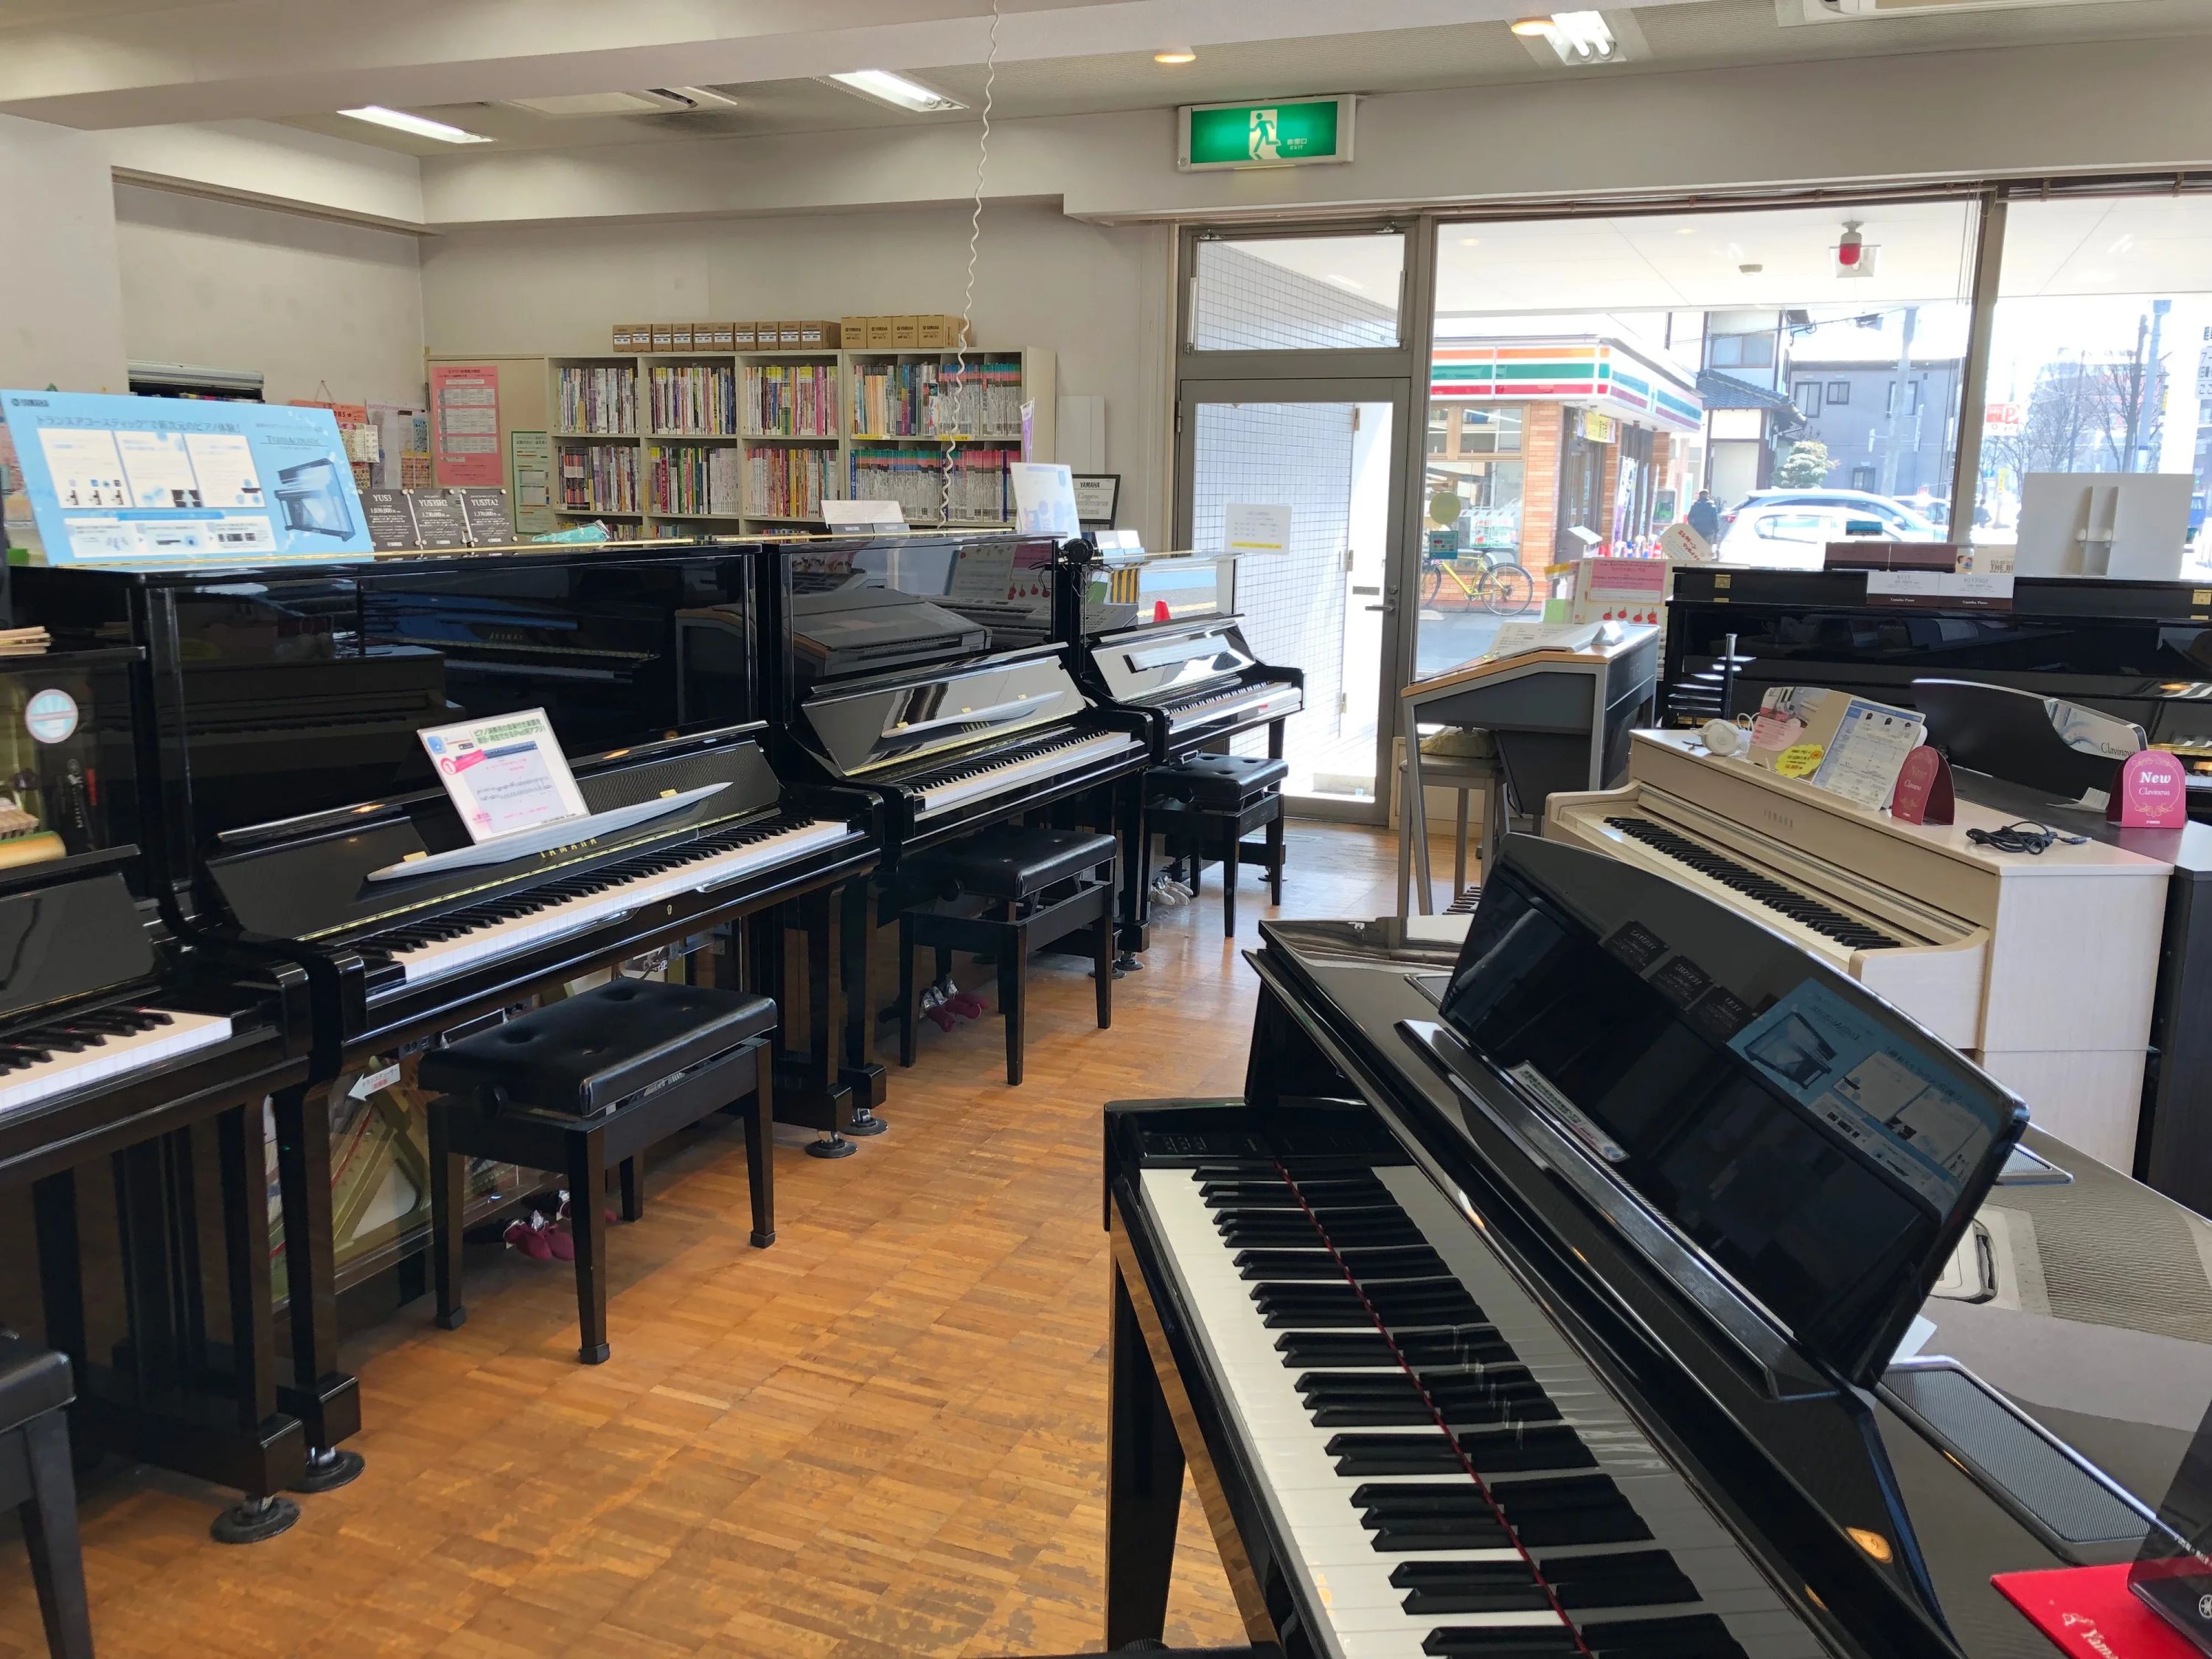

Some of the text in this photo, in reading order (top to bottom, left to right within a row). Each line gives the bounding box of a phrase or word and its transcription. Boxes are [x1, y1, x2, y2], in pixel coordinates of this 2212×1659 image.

[372, 494, 392, 502] YUS3
[2101, 742, 2136, 757] Clavinov
[2140, 771, 2171, 784] New
[2138, 787, 2171, 796] Clavinova
